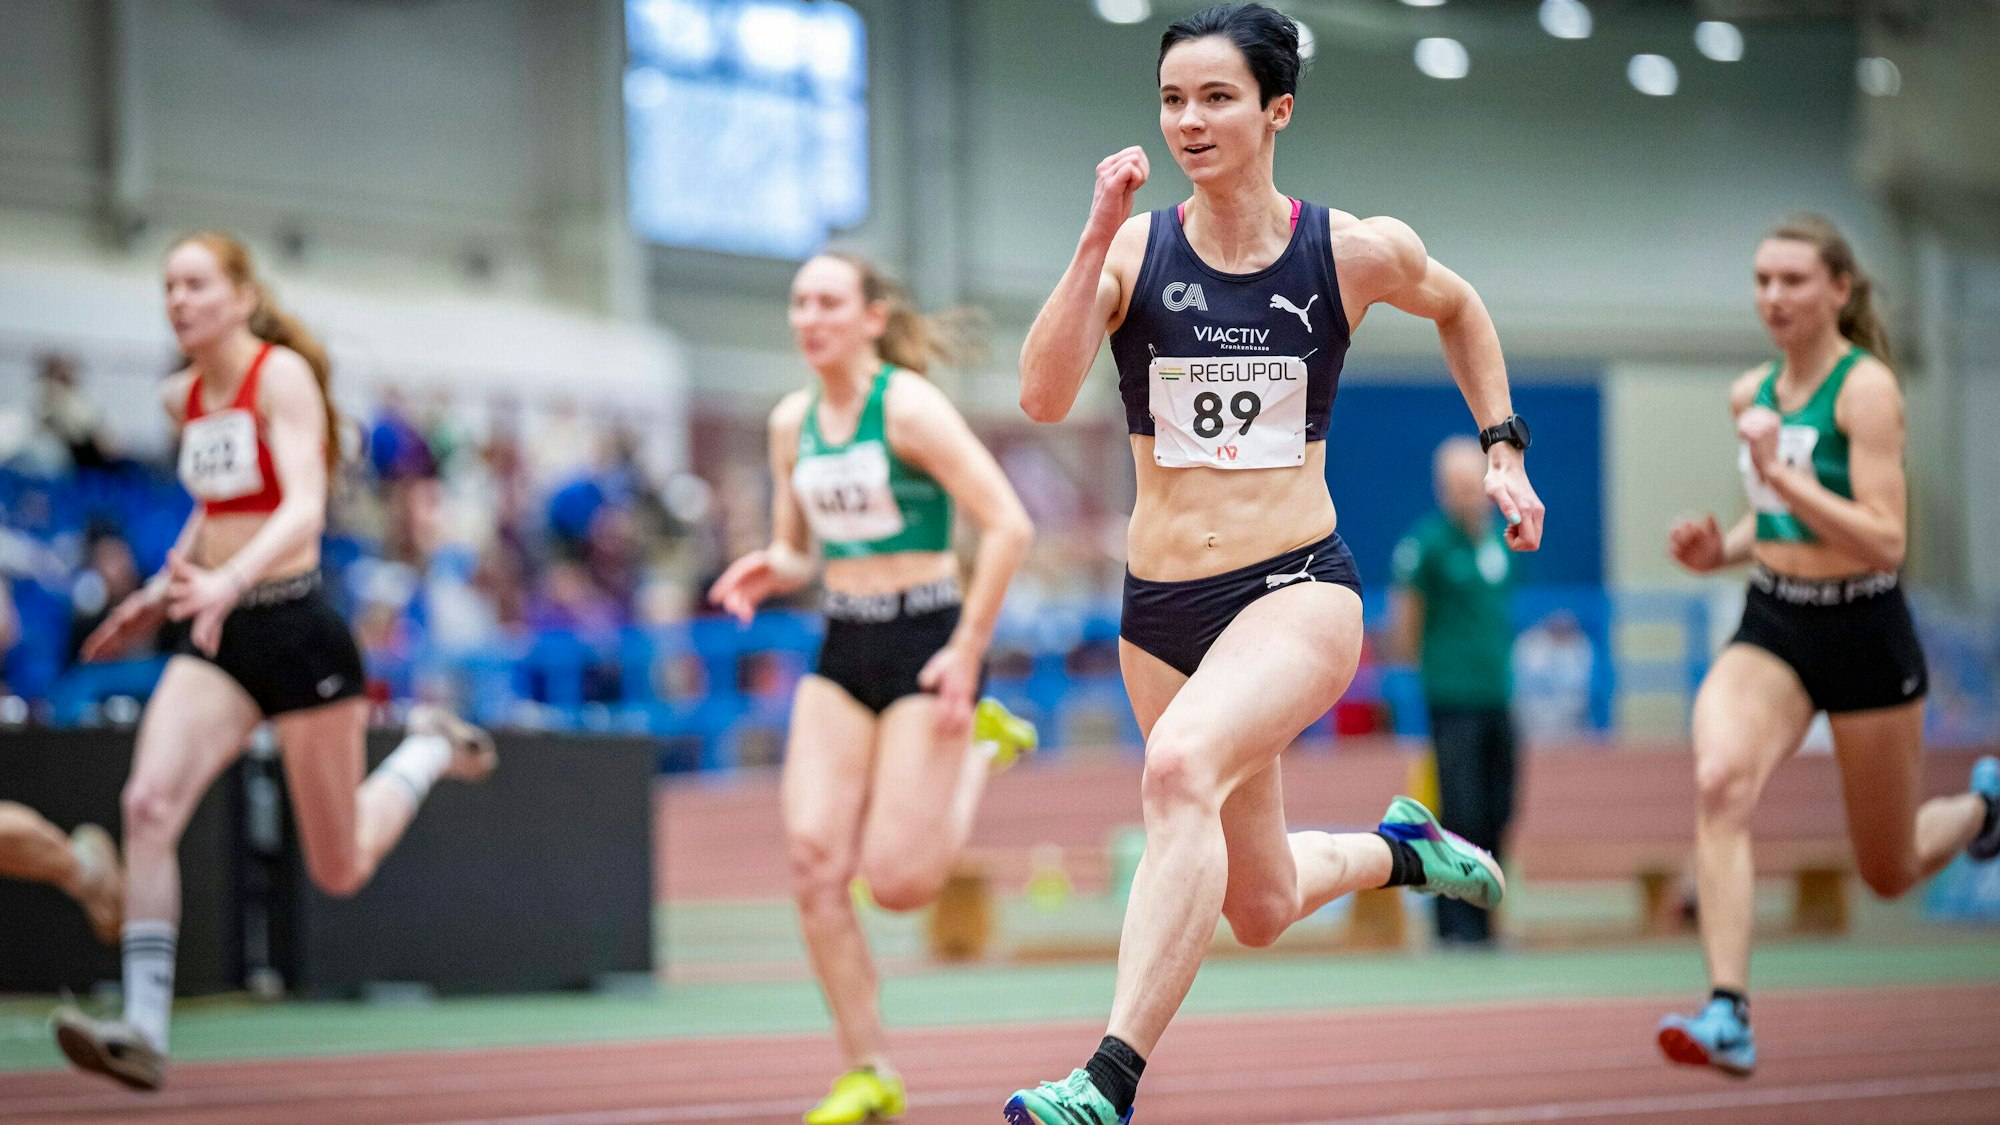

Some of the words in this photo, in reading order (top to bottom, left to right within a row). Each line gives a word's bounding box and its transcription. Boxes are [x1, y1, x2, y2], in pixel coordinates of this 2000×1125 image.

[1162, 281, 1209, 312] CA
[1193, 325, 1270, 344] VIACTIV
[1220, 343, 1270, 352] Krankenkasse
[1190, 362, 1297, 383] REGUPOL
[1193, 390, 1261, 439] 89
